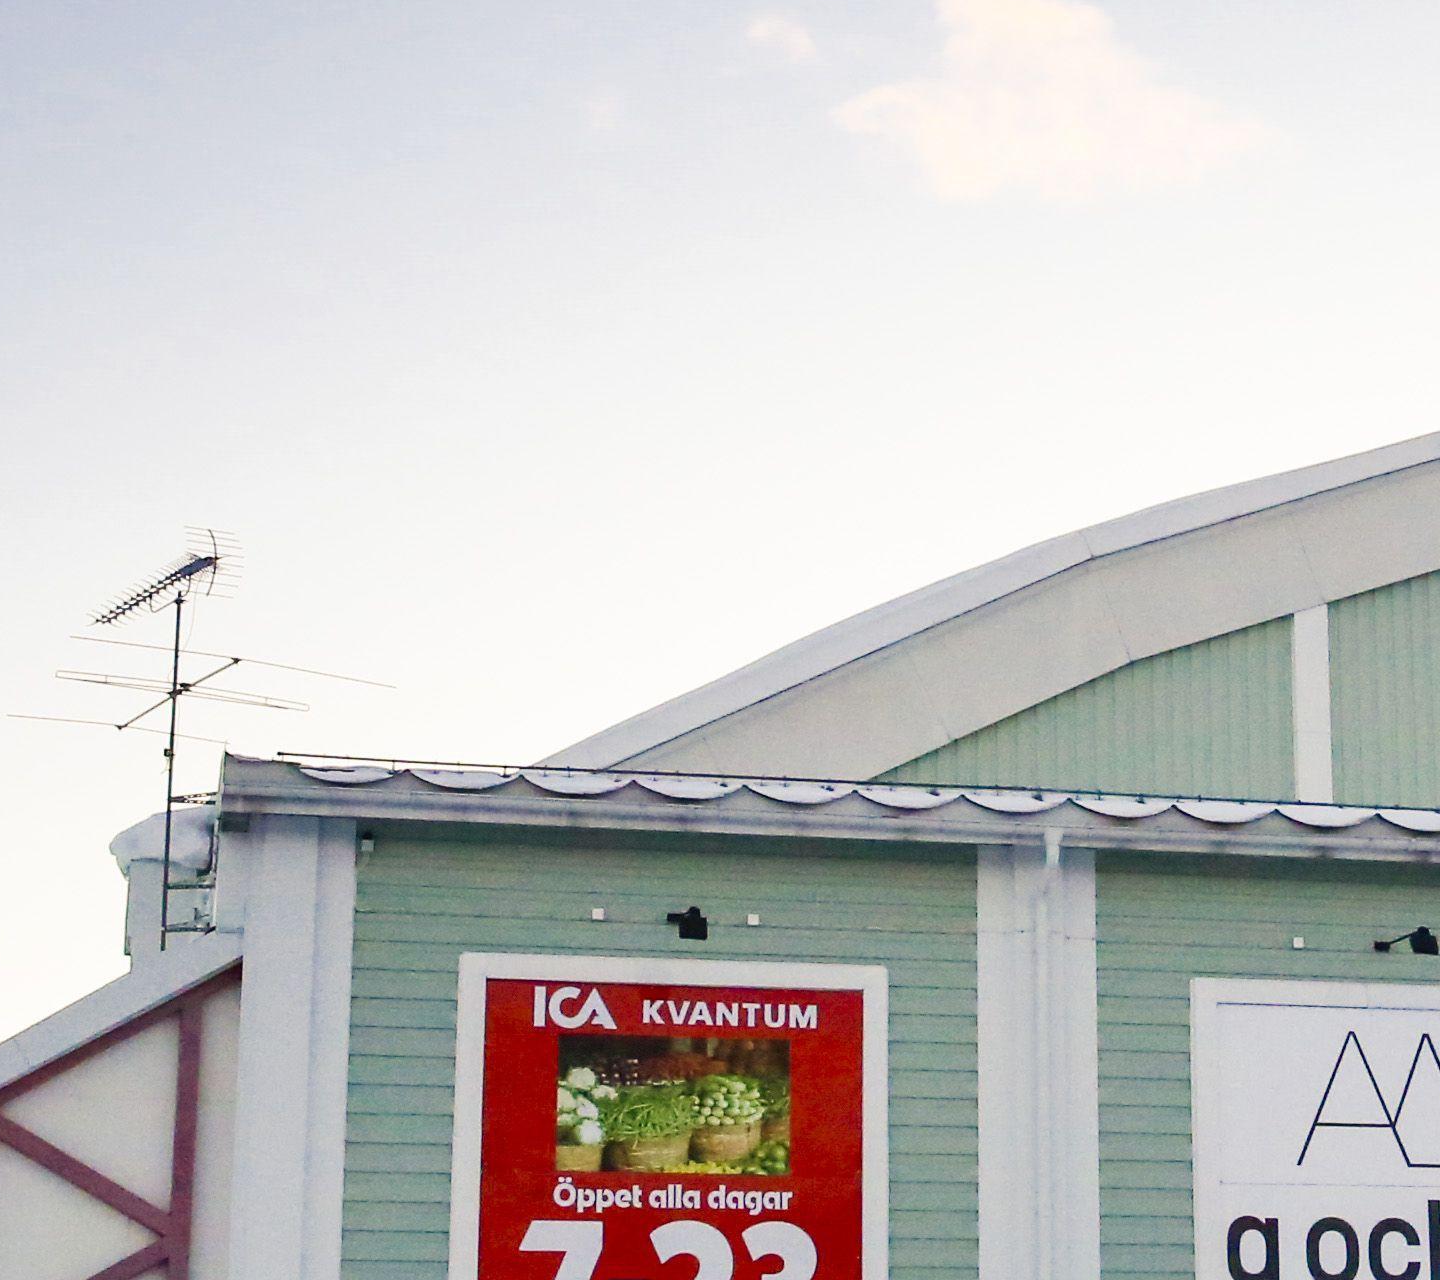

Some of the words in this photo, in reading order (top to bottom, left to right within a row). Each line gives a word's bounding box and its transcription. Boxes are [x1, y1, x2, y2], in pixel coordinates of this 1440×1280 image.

[533, 986, 617, 1029] ICA
[642, 999, 818, 1029] KVANTUM
[553, 1177, 642, 1212] Öppet
[648, 1184, 701, 1210] alla
[707, 1187, 793, 1216] dagar
